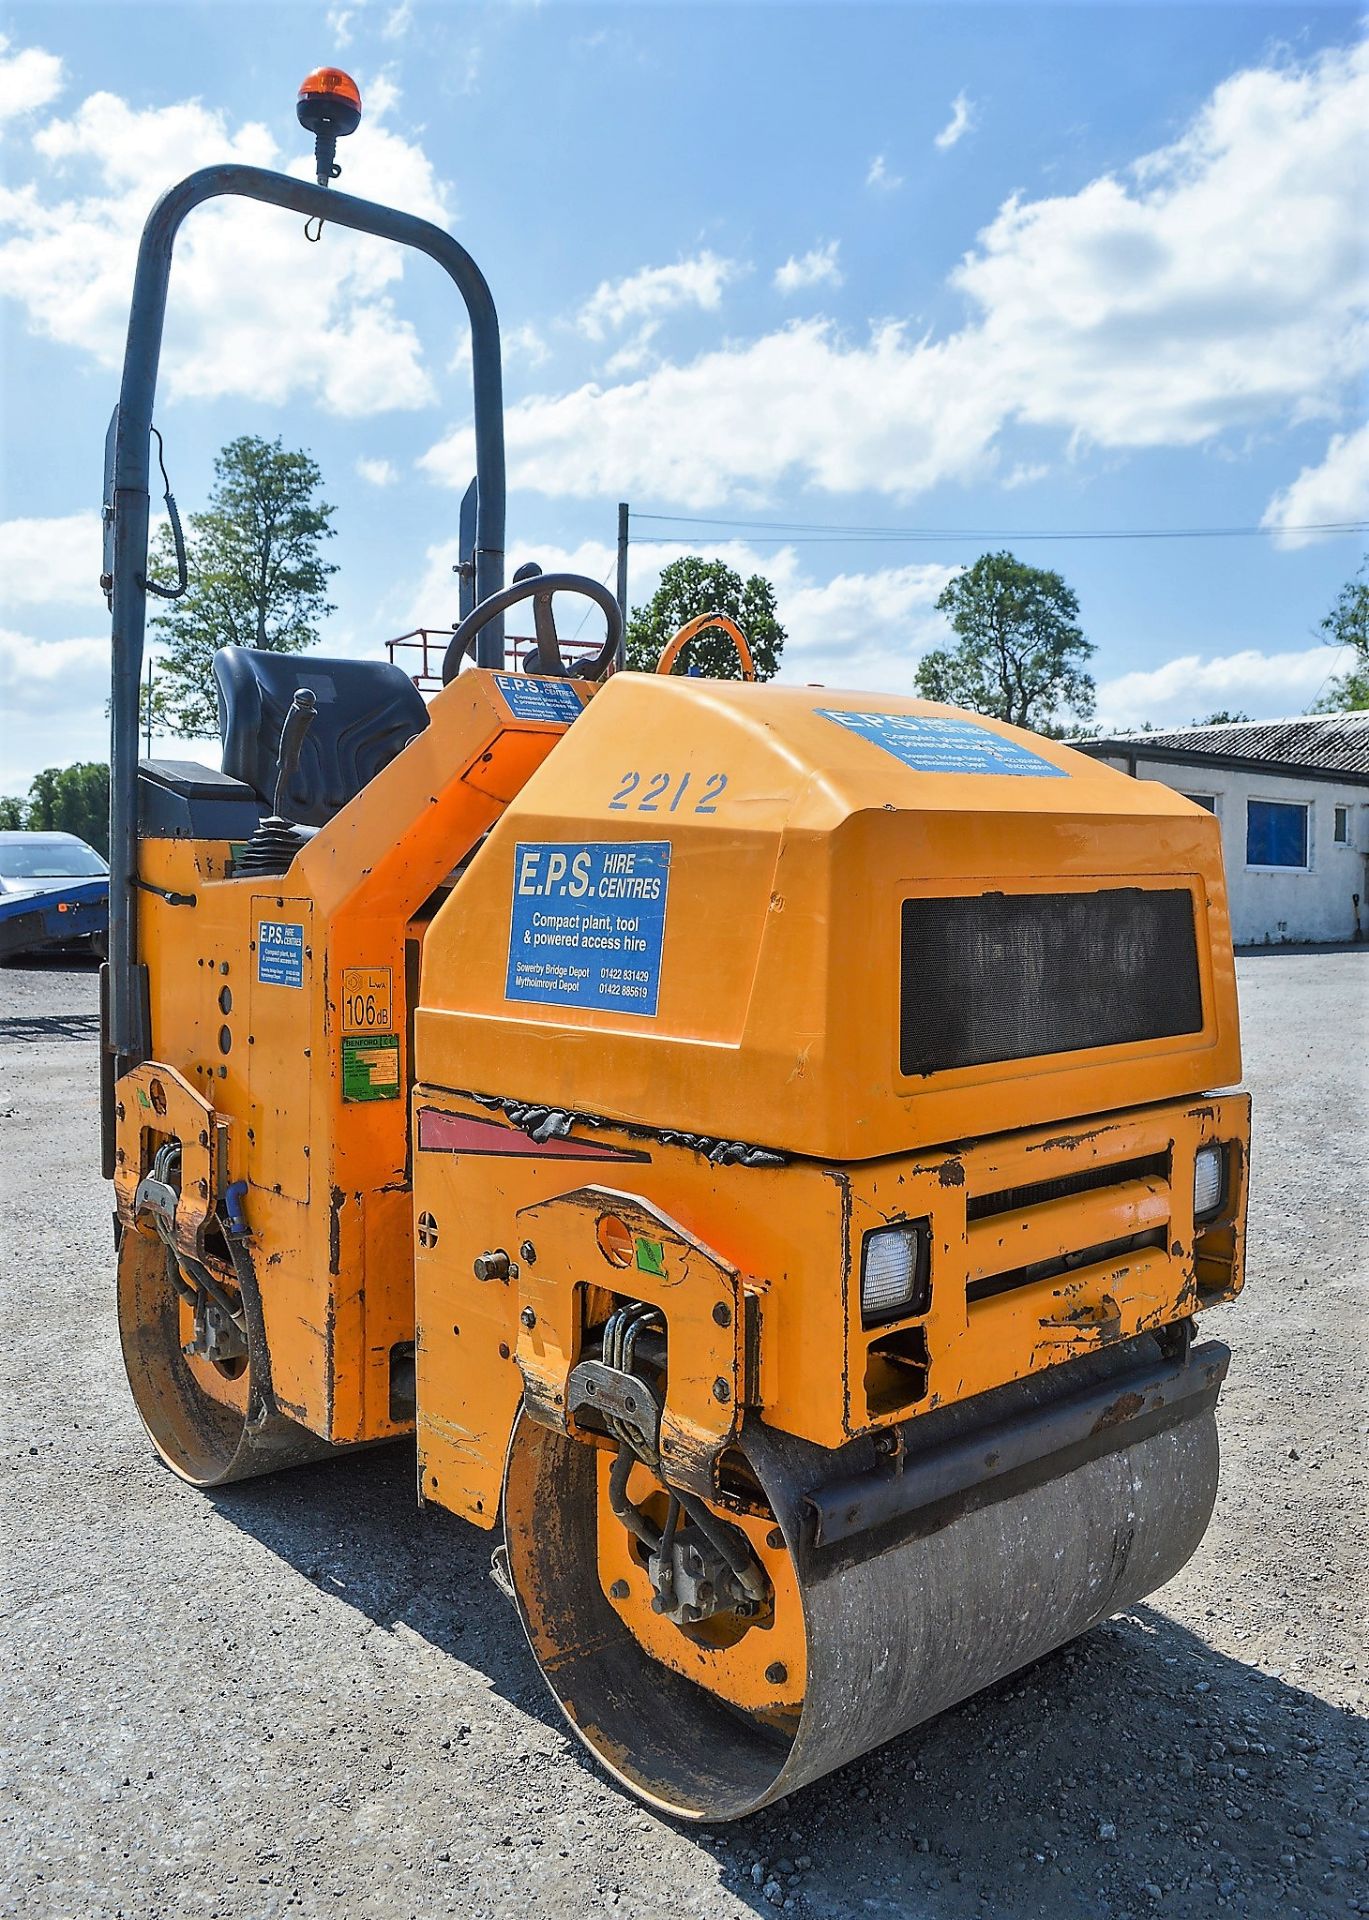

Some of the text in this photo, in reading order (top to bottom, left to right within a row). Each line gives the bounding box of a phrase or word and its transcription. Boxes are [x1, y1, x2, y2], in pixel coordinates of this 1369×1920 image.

[497, 677, 543, 694] E.P.S.
[608, 772, 728, 813] 2212
[518, 851, 595, 898] E.P.S.
[603, 853, 637, 874] HIRE
[598, 877, 661, 900] CENTRES
[532, 911, 639, 933] Compact plant, tool
[260, 924, 284, 945] E.P.S.
[523, 929, 647, 952] & powered access hire
[516, 961, 649, 983] Sowerby Bridge Depot 01422 831429
[558, 979, 580, 993] Depot
[599, 982, 621, 996] 01422
[621, 984, 648, 998] 885619
